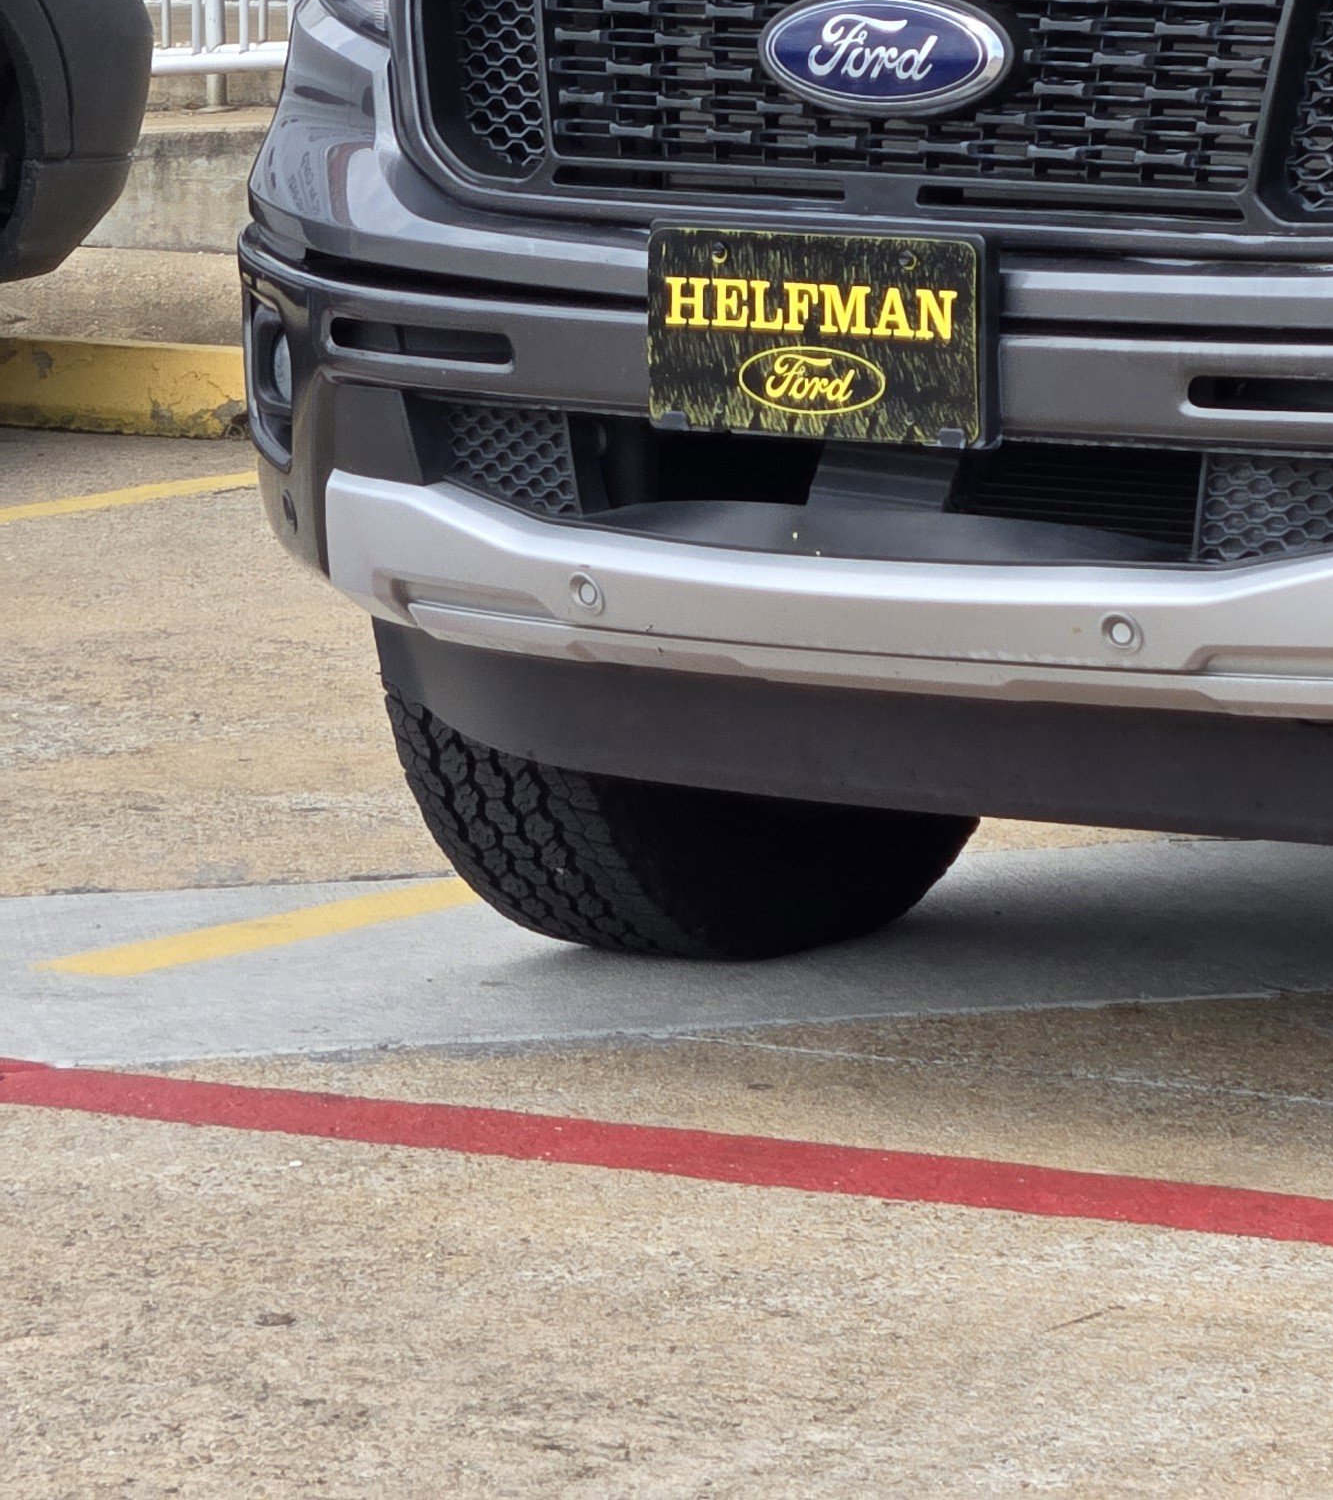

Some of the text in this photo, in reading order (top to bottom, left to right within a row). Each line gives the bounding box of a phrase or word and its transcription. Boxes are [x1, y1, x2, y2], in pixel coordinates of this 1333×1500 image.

[807, 13, 939, 81] Ford
[664, 275, 959, 342] HELFMAN
[765, 353, 856, 403] Ford
